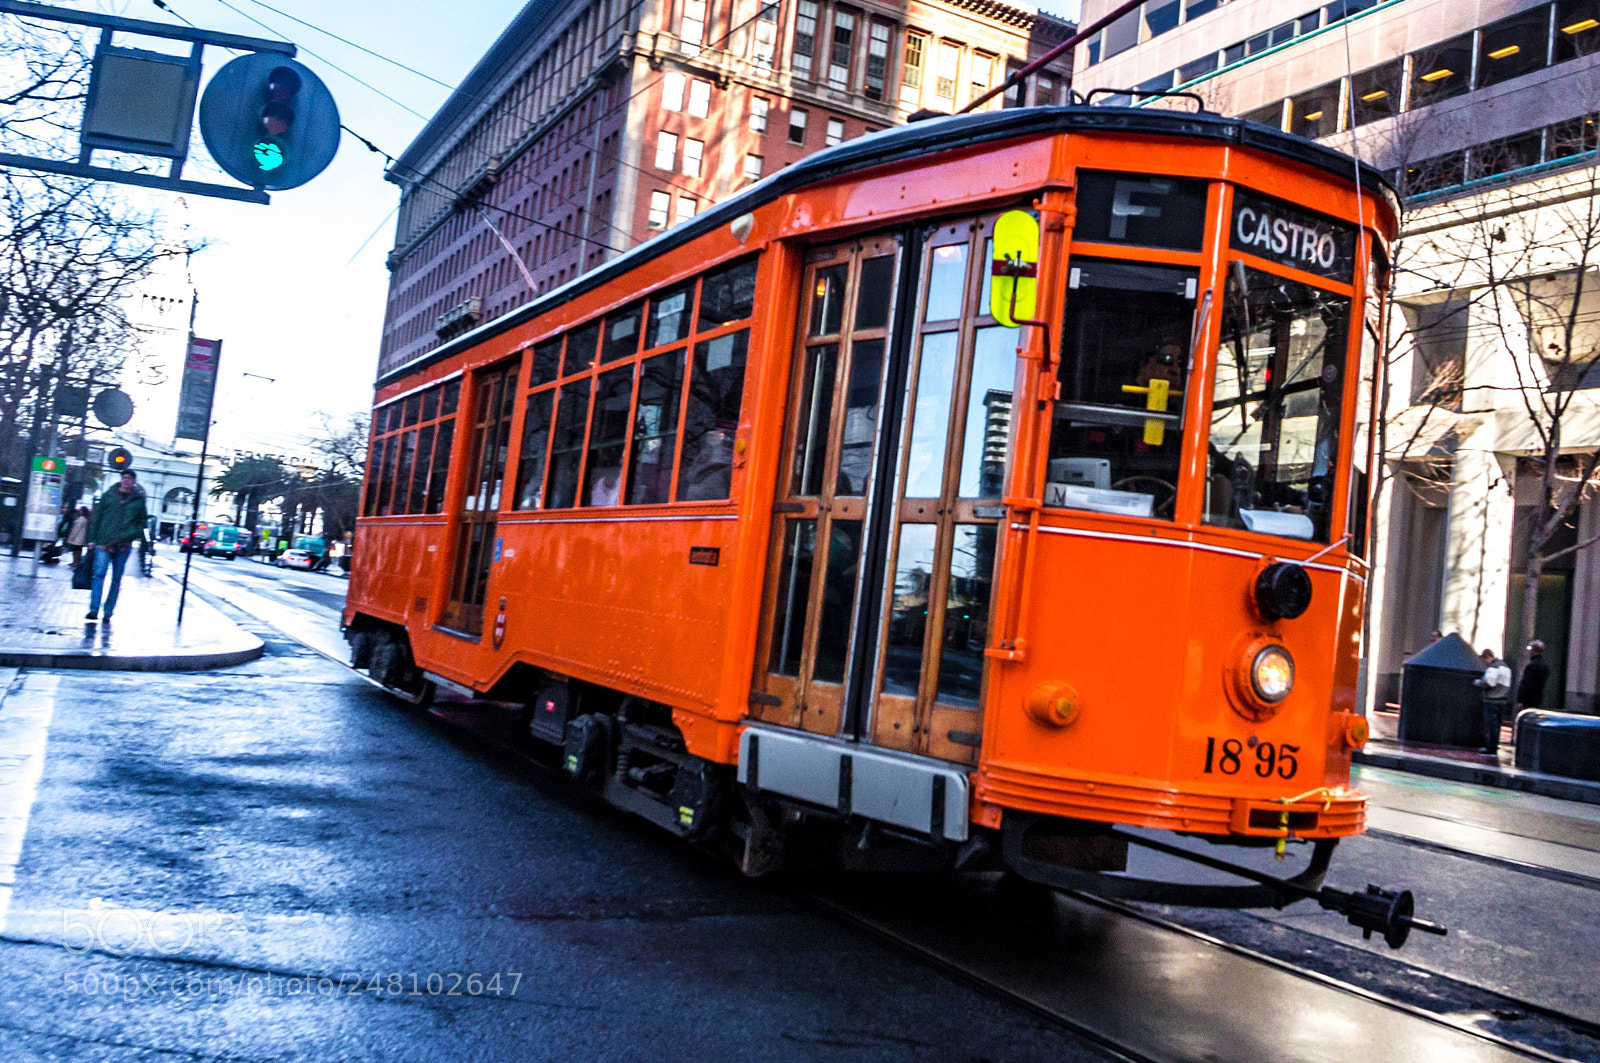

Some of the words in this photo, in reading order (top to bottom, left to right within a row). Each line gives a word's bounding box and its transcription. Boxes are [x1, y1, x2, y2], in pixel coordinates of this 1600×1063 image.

[1109, 180, 1171, 239] F
[1237, 207, 1336, 268] CASTRO
[1203, 737, 1300, 779] 1895
